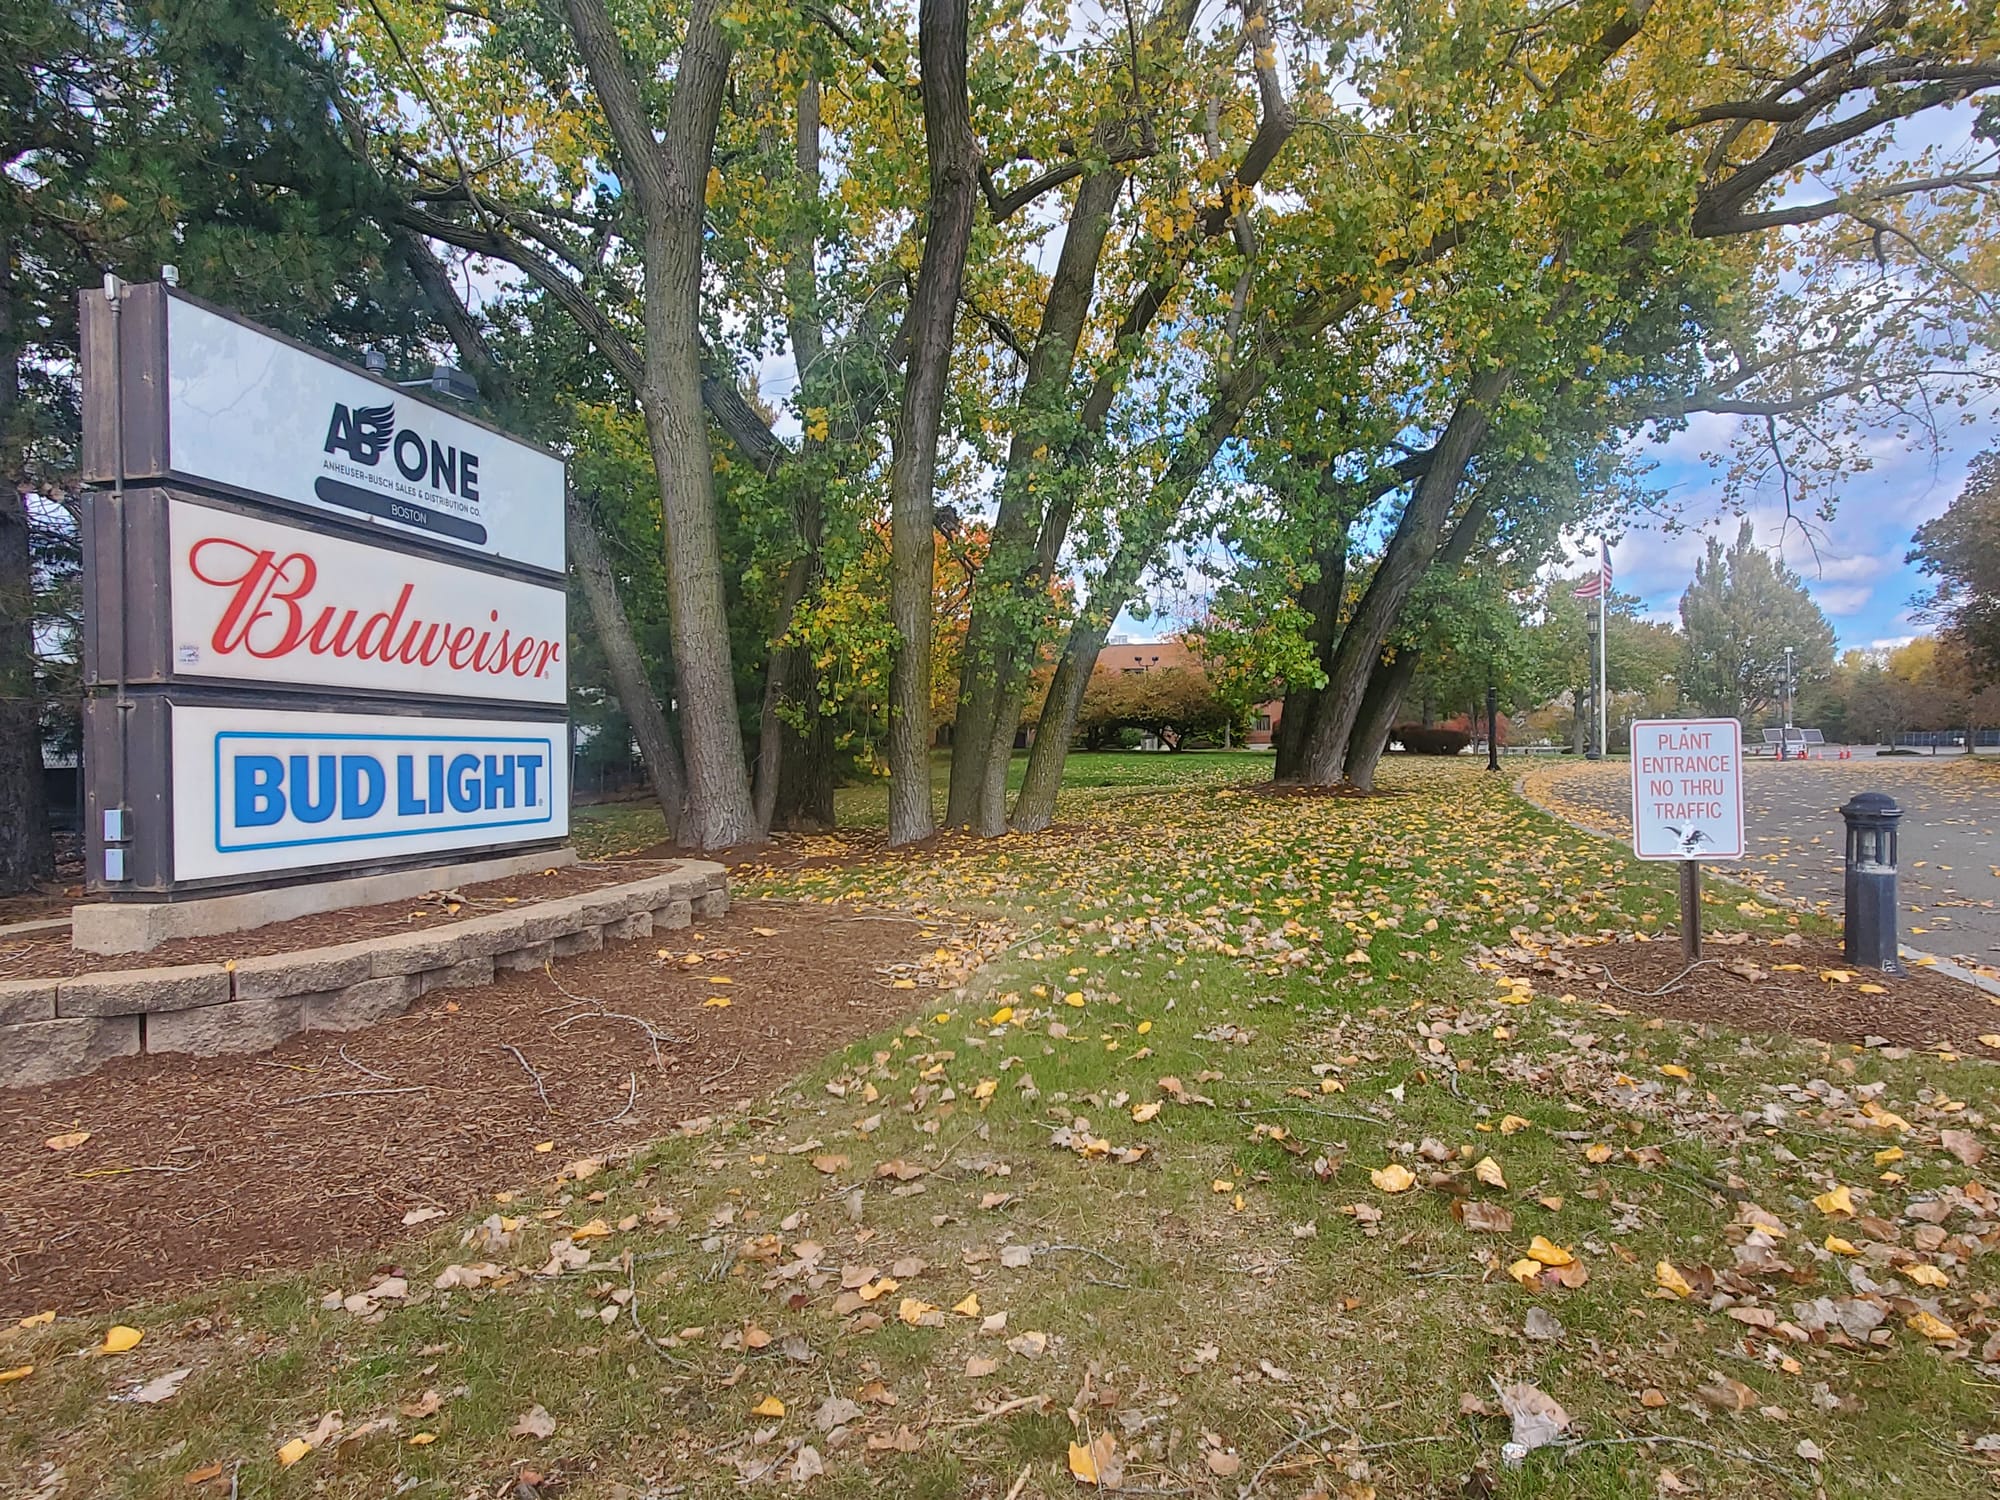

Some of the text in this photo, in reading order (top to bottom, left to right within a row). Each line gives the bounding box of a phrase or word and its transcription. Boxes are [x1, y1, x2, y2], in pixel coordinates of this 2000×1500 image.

[394, 429, 479, 502] ONE
[323, 460, 480, 517] ANHEUSER-BUSCH SALES & DISTRIBUTION CO.
[391, 503, 427, 524] BOSTON
[188, 537, 560, 678] Budweiser
[1658, 733, 1712, 751] PLANT
[1642, 755, 1730, 774] ENTRANCE
[234, 753, 543, 828] BUD LIGHT
[1650, 779, 1724, 797] NO THRU
[1654, 801, 1722, 820] TRAFFIC
